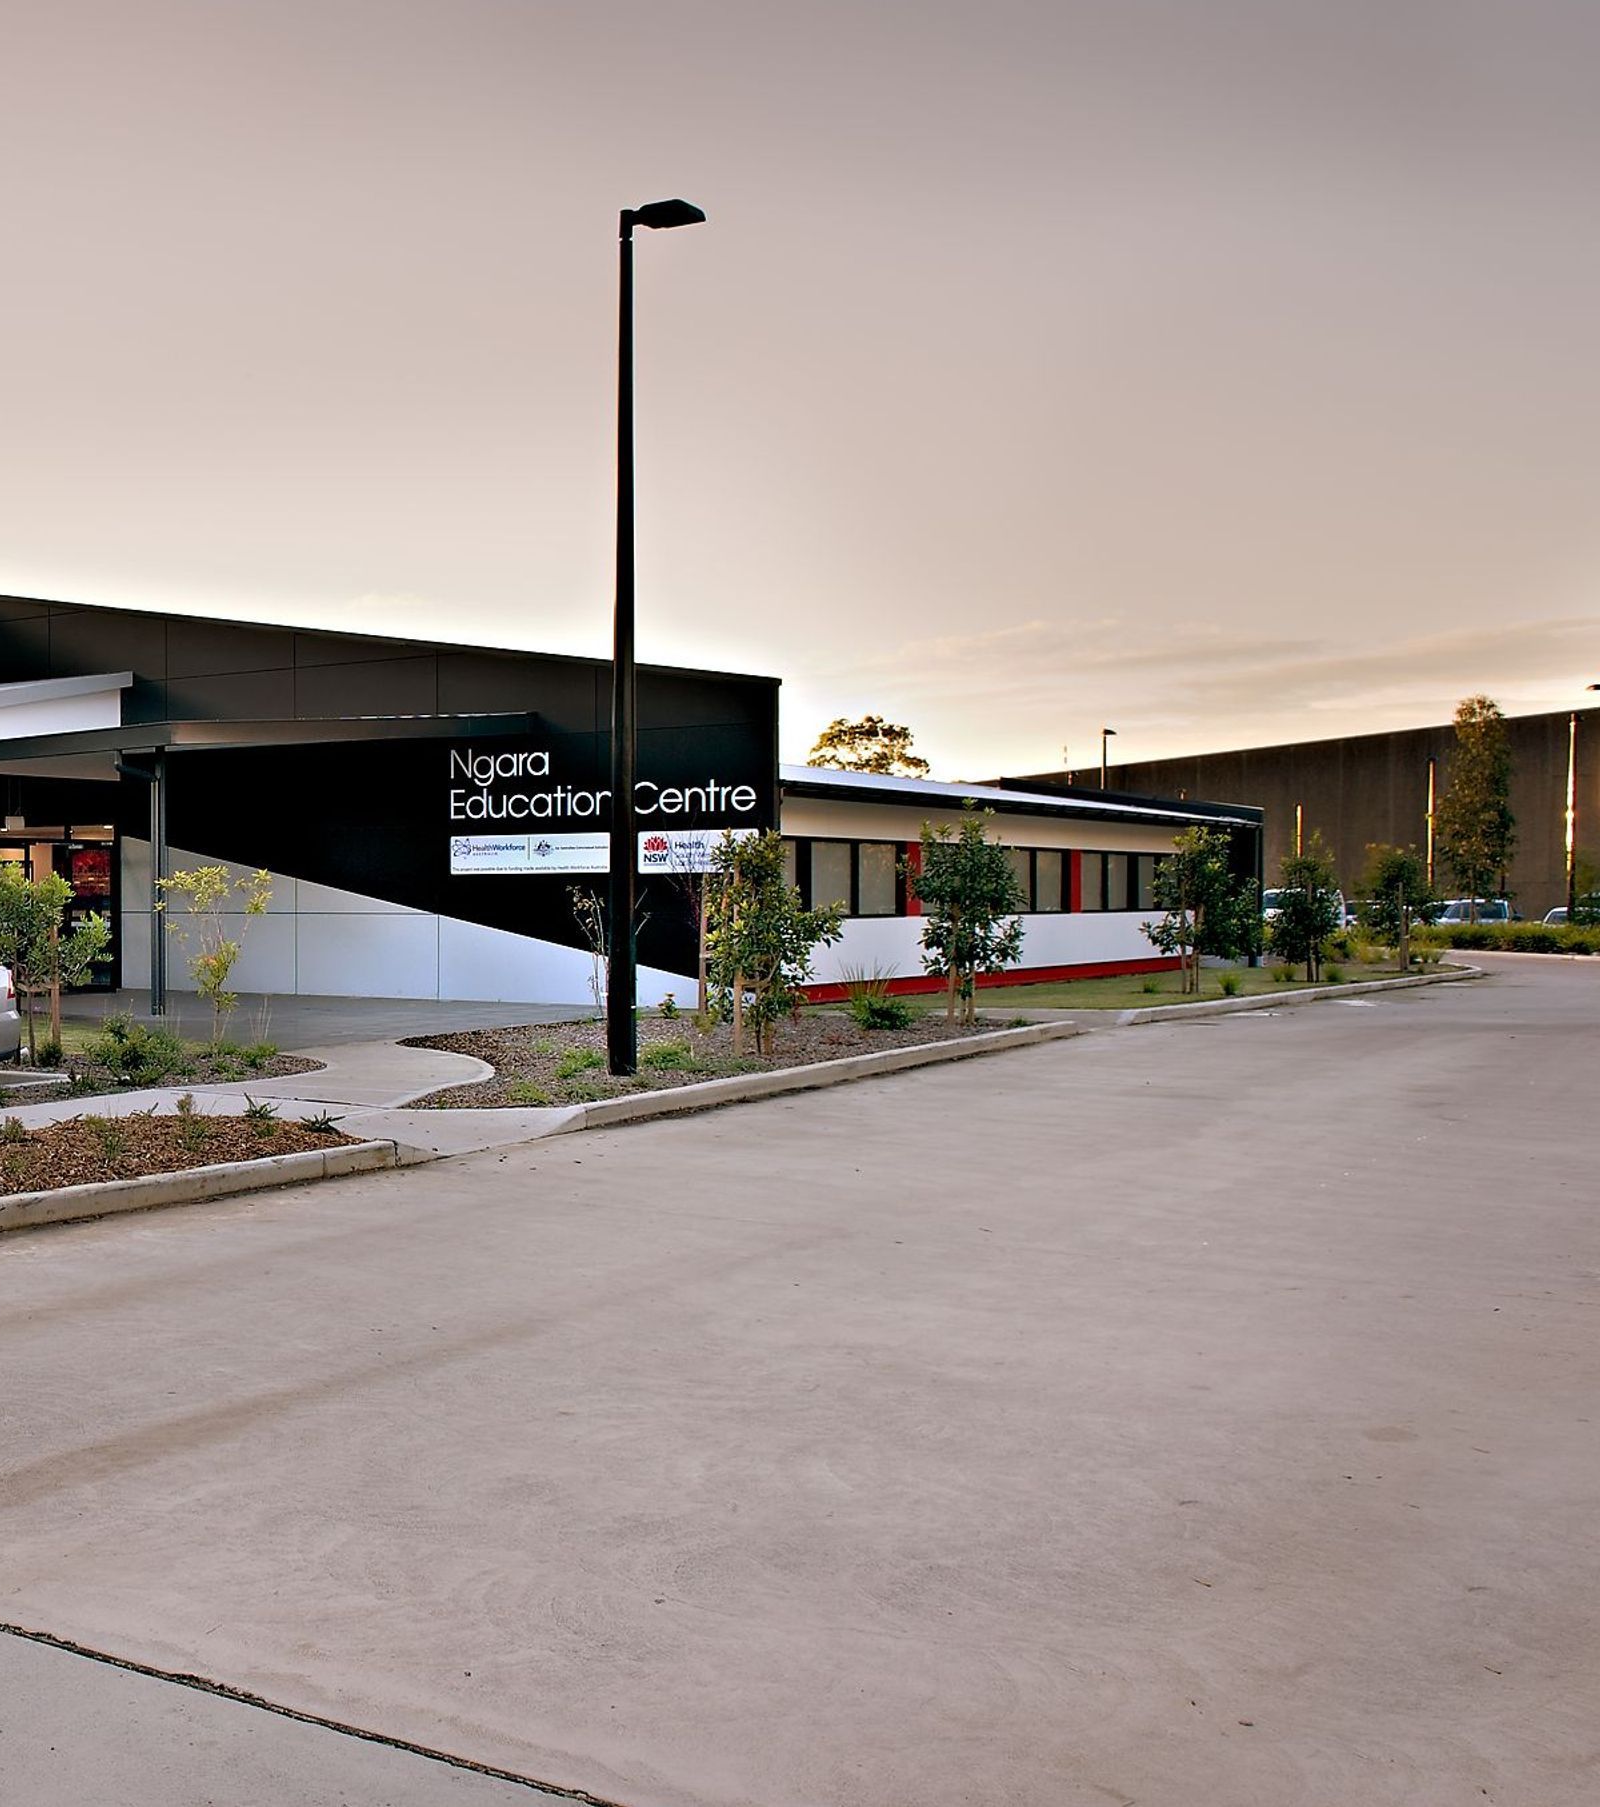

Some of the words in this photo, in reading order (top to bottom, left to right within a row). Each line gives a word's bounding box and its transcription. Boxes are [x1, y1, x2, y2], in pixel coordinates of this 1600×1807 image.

[450, 748, 550, 787] Ngara
[450, 784, 612, 820] Education
[634, 778, 757, 815] Centre
[674, 841, 705, 849] Health
[643, 853, 669, 862] NSW
